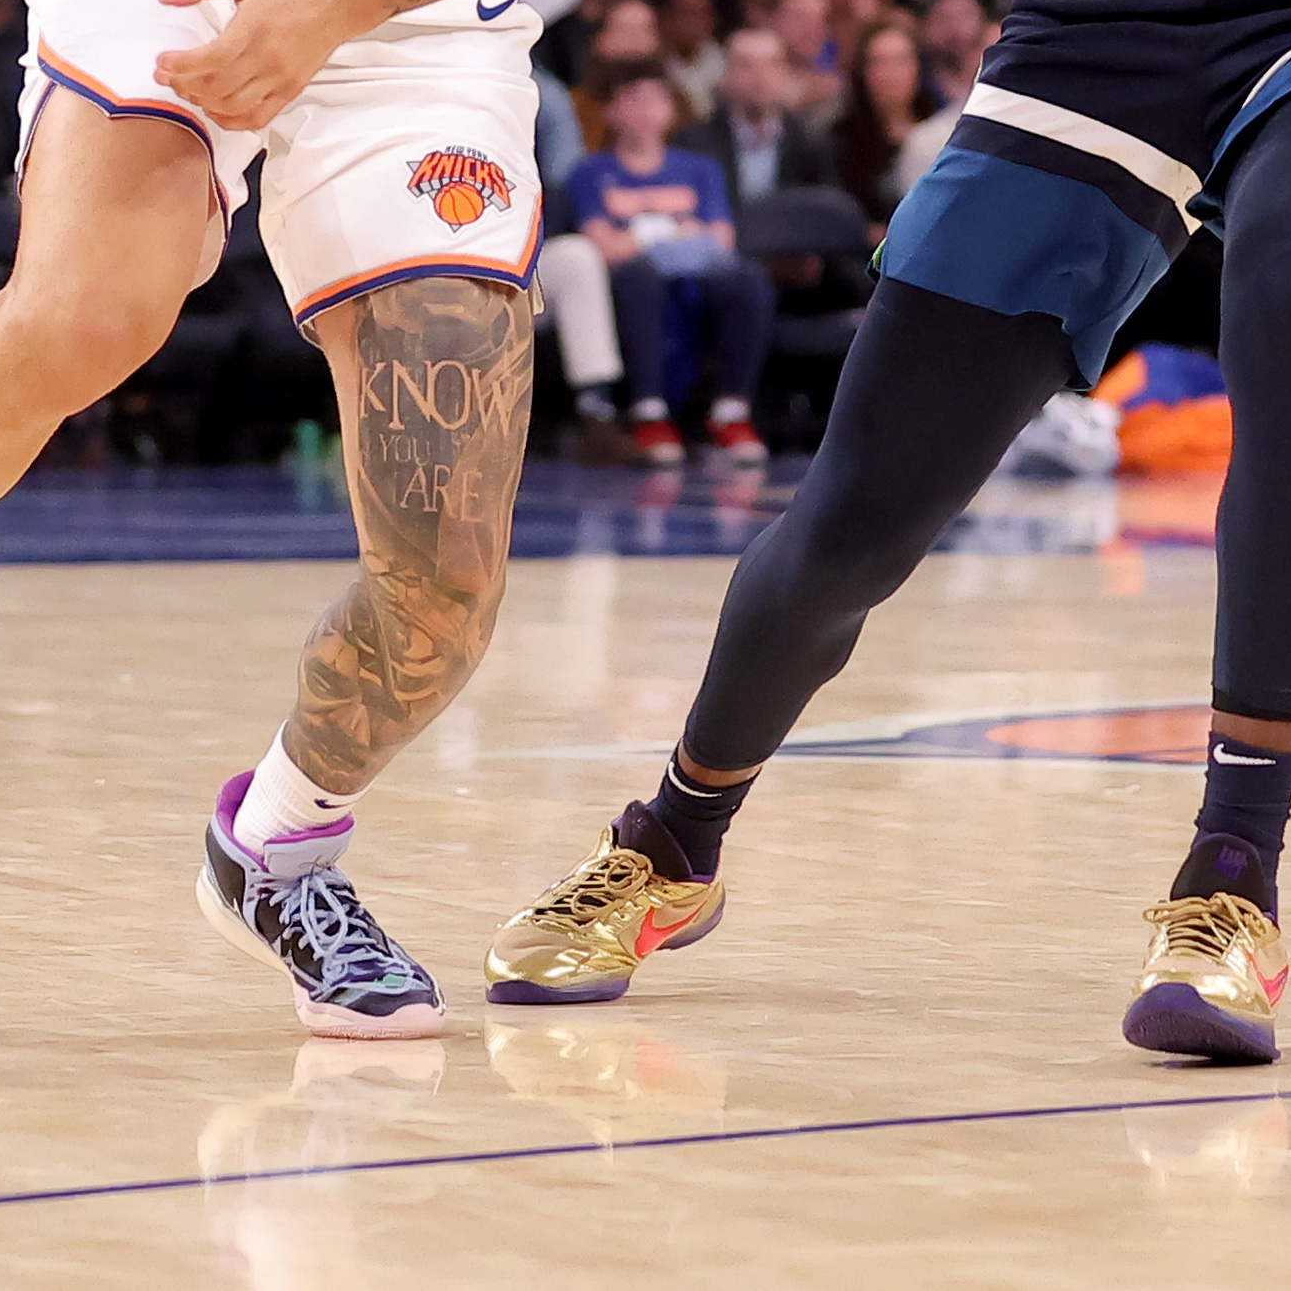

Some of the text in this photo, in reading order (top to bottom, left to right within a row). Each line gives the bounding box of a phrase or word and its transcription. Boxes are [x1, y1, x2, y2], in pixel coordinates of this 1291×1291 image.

[407, 150, 511, 209] KNICKS
[445, 145, 464, 155] NEW
[360, 359, 526, 436] KNOW
[399, 463, 484, 523] ARE
